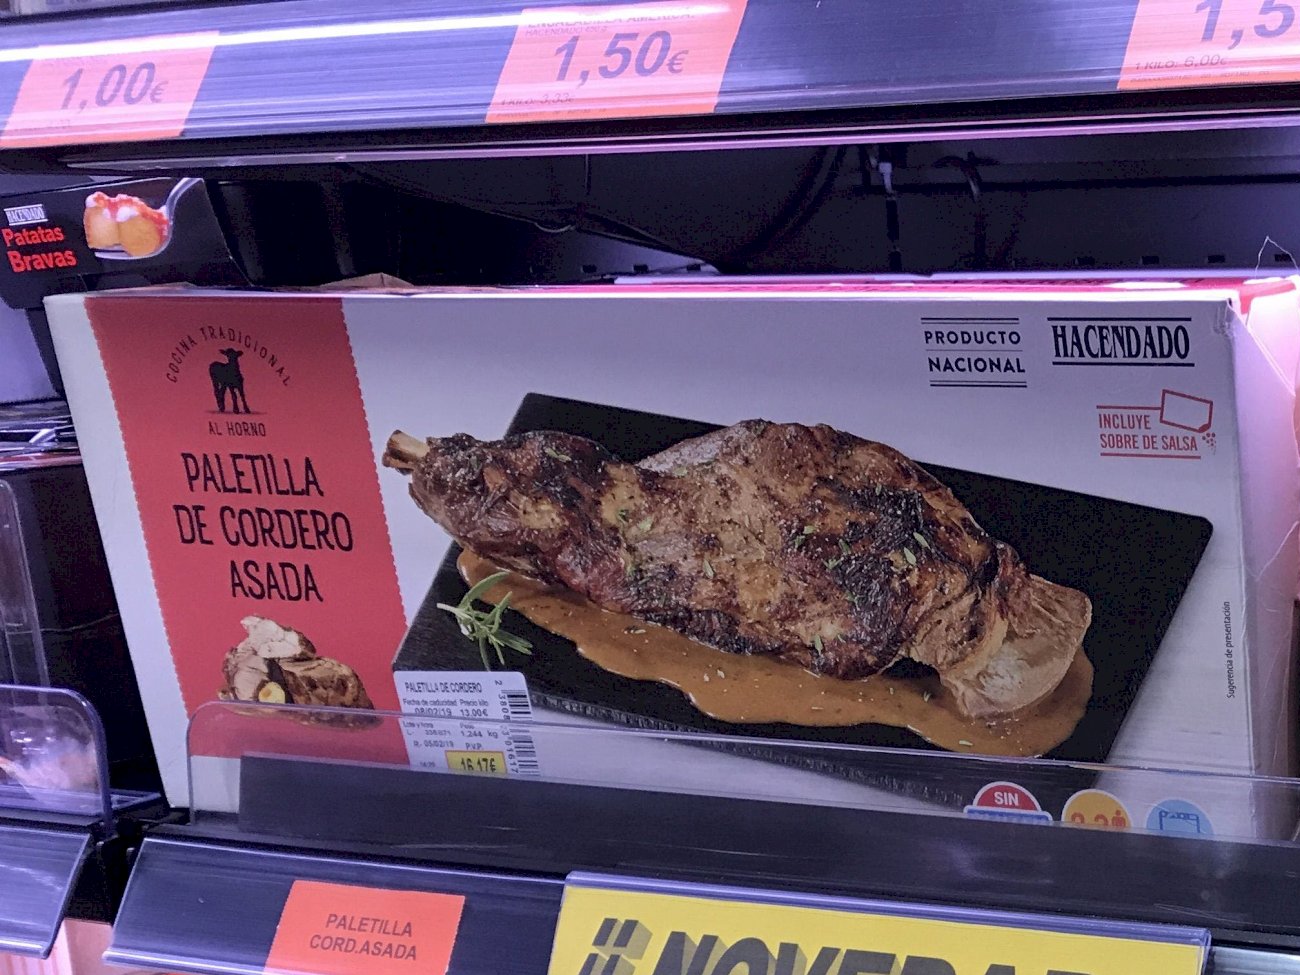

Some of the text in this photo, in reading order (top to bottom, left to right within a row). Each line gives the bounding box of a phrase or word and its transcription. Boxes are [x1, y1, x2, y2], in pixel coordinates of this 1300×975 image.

[554, 30, 689, 89] 1,50€
[61, 61, 169, 113] 1,00€
[1, 225, 65, 247] Patatas
[7, 250, 77, 273] Bravas
[924, 329, 1021, 346] PRODUCTO
[1051, 323, 1191, 361] HACENDADO
[166, 324, 293, 387] COCINA TRADICIONAL
[928, 356, 1027, 374] NACIONAL
[208, 420, 267, 438] AL HORNO
[1098, 412, 1151, 430] INCLUYE
[1100, 432, 1198, 452] SOBRE DE SALSA
[181, 452, 324, 498] PALETILLA
[173, 504, 354, 552] DE CORDERO
[230, 559, 324, 603] ASADA
[1222, 601, 1237, 699] Sugerencia de presentación
[404, 681, 483, 694] PALETILLA DE CORDERO
[993, 791, 1019, 806] SIN
[325, 912, 412, 938] PALETILLA
[309, 934, 416, 961] CORD.ASADA
